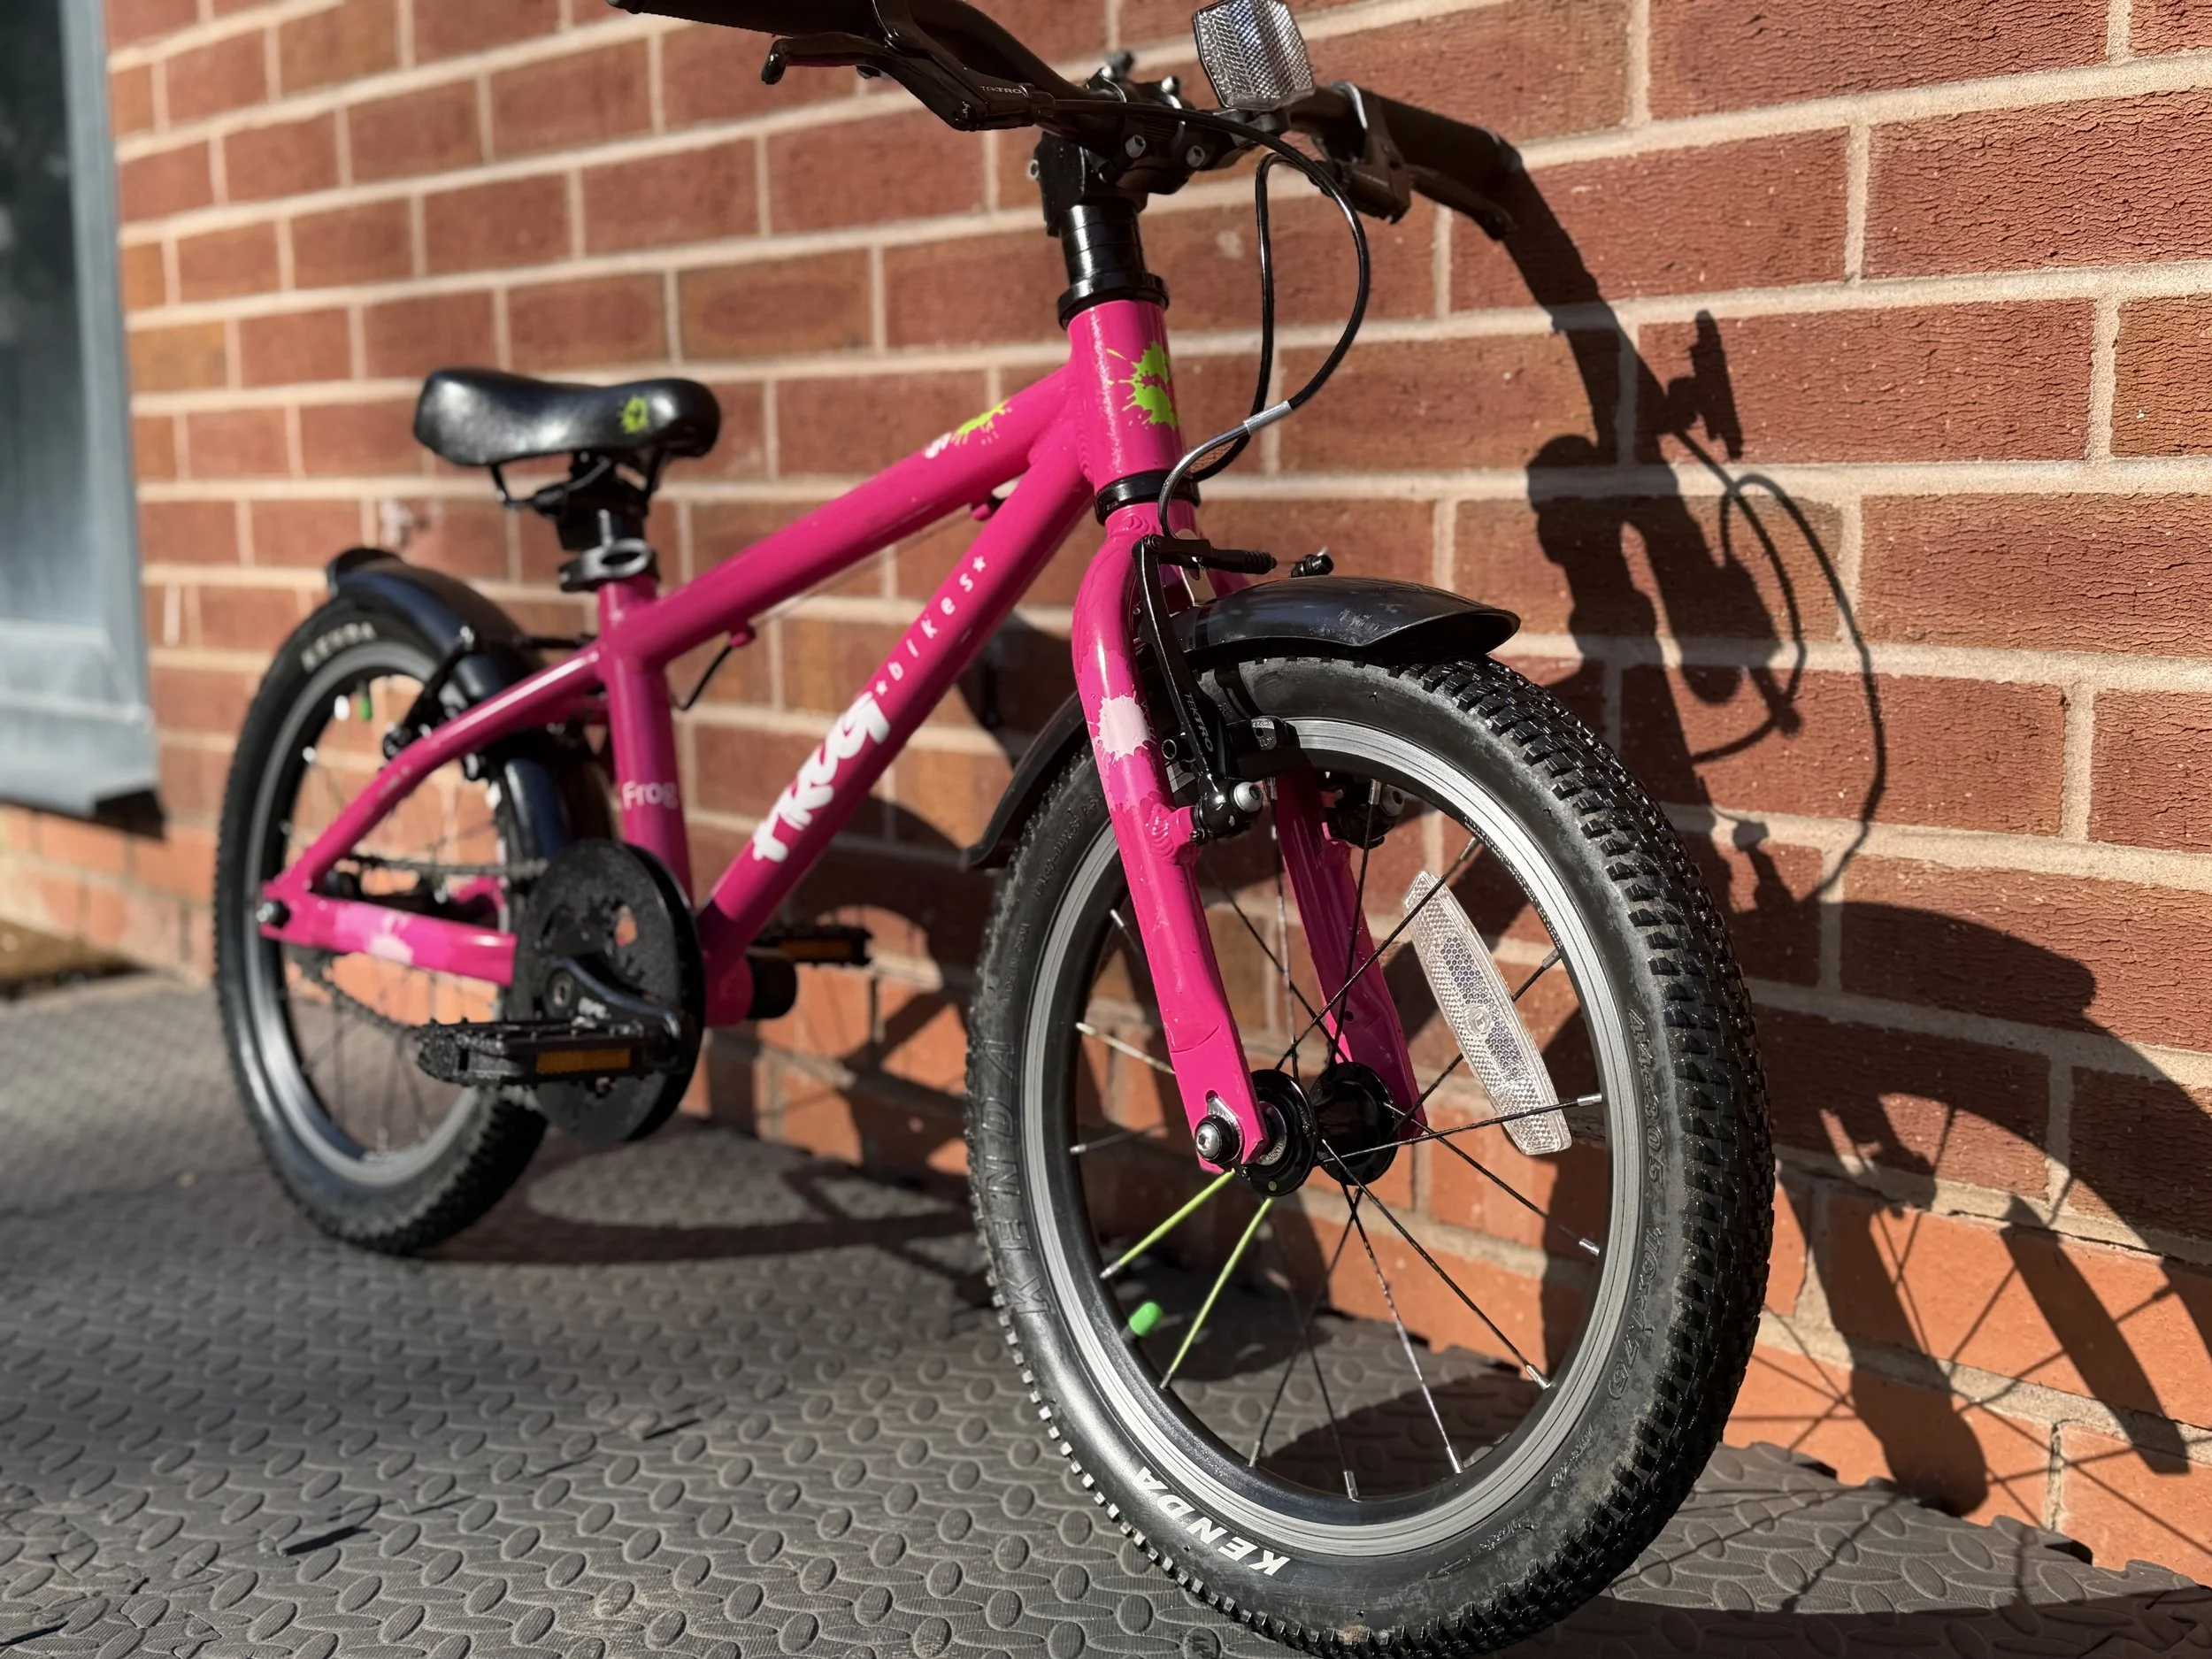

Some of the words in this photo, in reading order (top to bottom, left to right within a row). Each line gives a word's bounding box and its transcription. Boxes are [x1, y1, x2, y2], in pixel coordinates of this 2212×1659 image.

[1185, 692, 1214, 753] TEKTRO
[1626, 1006, 1665, 1187] 44-305
[981, 1040, 1050, 1316] KENDA
[1132, 1464, 1291, 1577] KENDA
